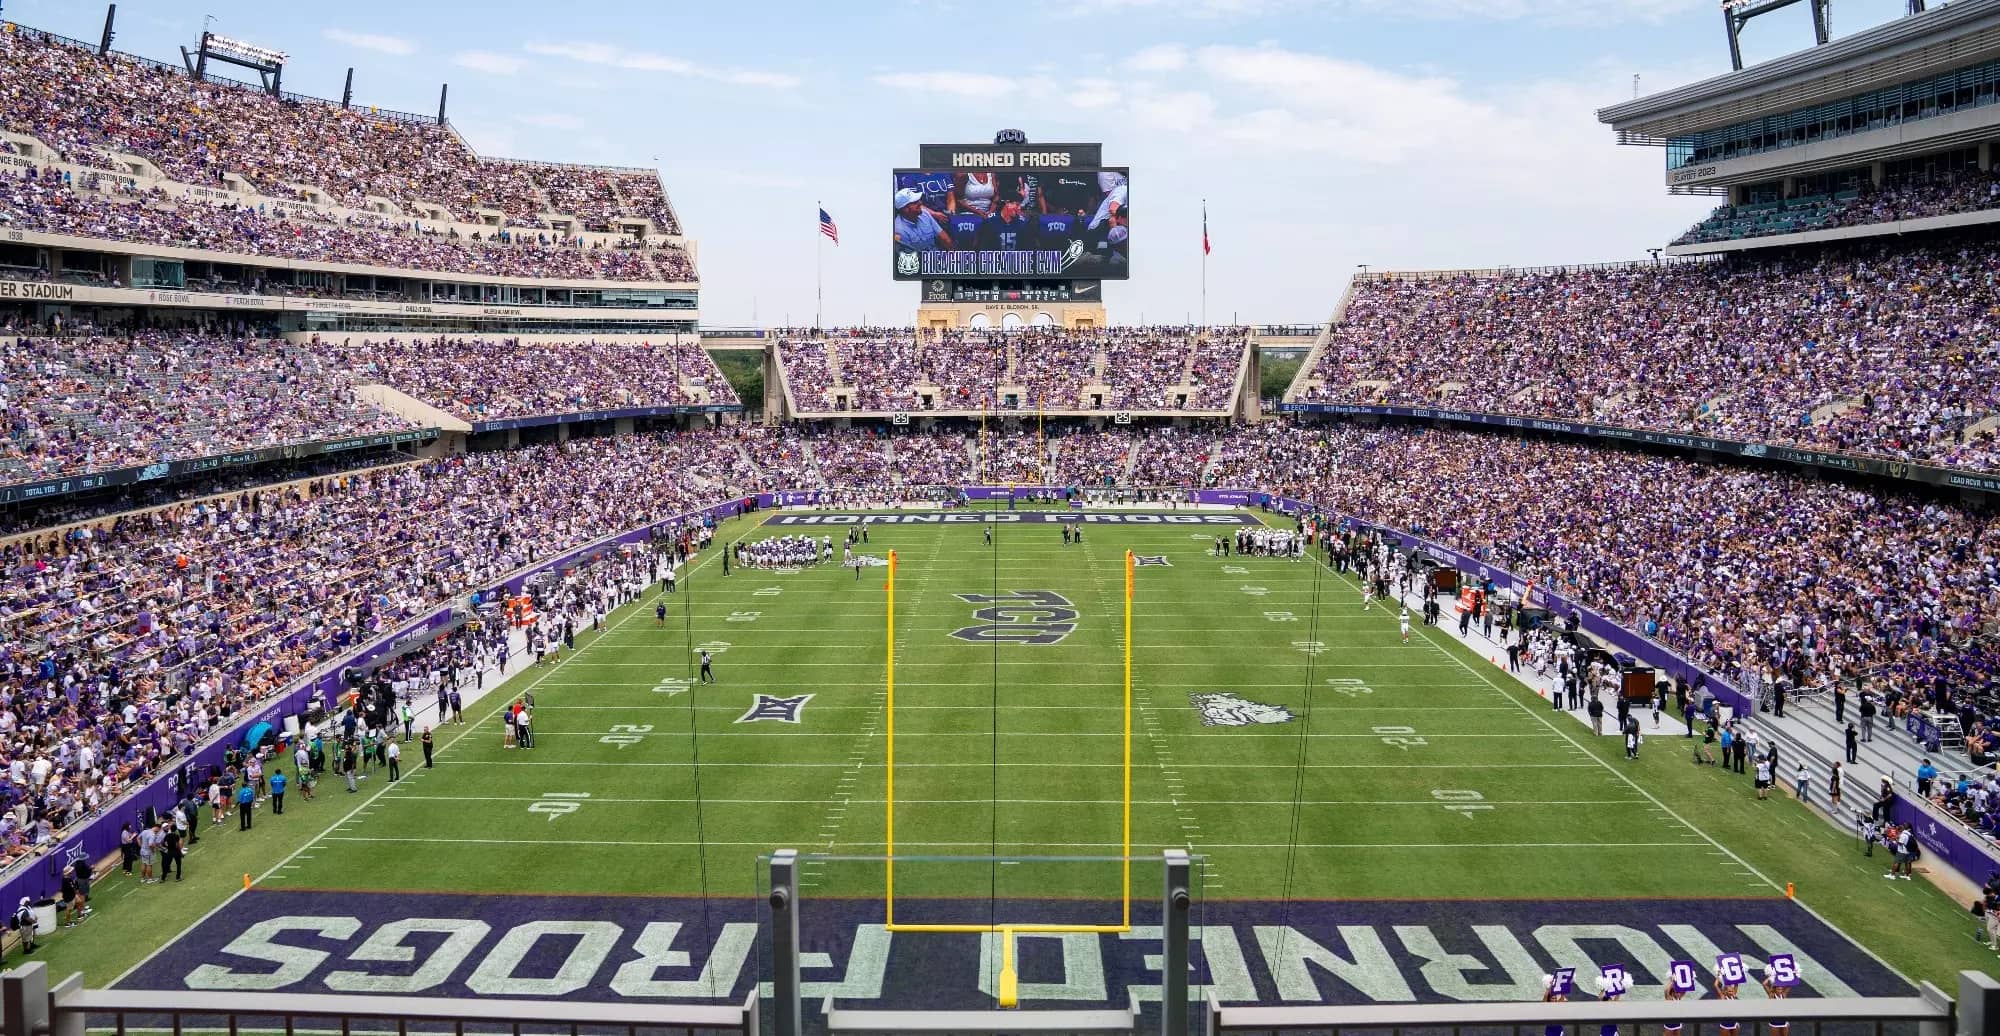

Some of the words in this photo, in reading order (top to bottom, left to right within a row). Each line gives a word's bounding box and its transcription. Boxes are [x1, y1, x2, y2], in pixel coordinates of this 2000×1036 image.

[996, 129, 1025, 142] TCU
[953, 153, 1014, 167] HORNED
[1020, 153, 1070, 167] FROGS
[1697, 167, 1716, 177] 2023
[958, 222, 975, 232] TCU
[1047, 222, 1066, 232] TCU
[1000, 232, 1016, 250] 15
[922, 251, 977, 275] BLEACHER
[979, 251, 1034, 275] CREATURE
[1036, 250, 1062, 274] CAM
[22, 284, 73, 299] STADIUM
[929, 291, 947, 300] Frost
[895, 414, 908, 422] 25
[1117, 414, 1129, 422] 25
[1951, 476, 1964, 484] LEAD
[25, 488, 43, 497] TOTAL
[779, 514, 1018, 524] HORNED
[1044, 514, 1242, 523] FROGS
[947, 590, 1080, 644] TCU
[652, 677, 698, 692] 30
[1326, 679, 1374, 693] 30
[599, 725, 655, 743] 20
[1372, 726, 1429, 744] 20
[528, 792, 591, 814] 10
[1431, 789, 1494, 810] 10
[183, 916, 893, 999] FROGS
[978, 924, 1859, 1001] HORNED
[1553, 970, 1571, 991] F
[1604, 968, 1624, 992] R
[1675, 964, 1693, 988] O
[1722, 957, 1742, 981] G
[1774, 957, 1795, 982] S
